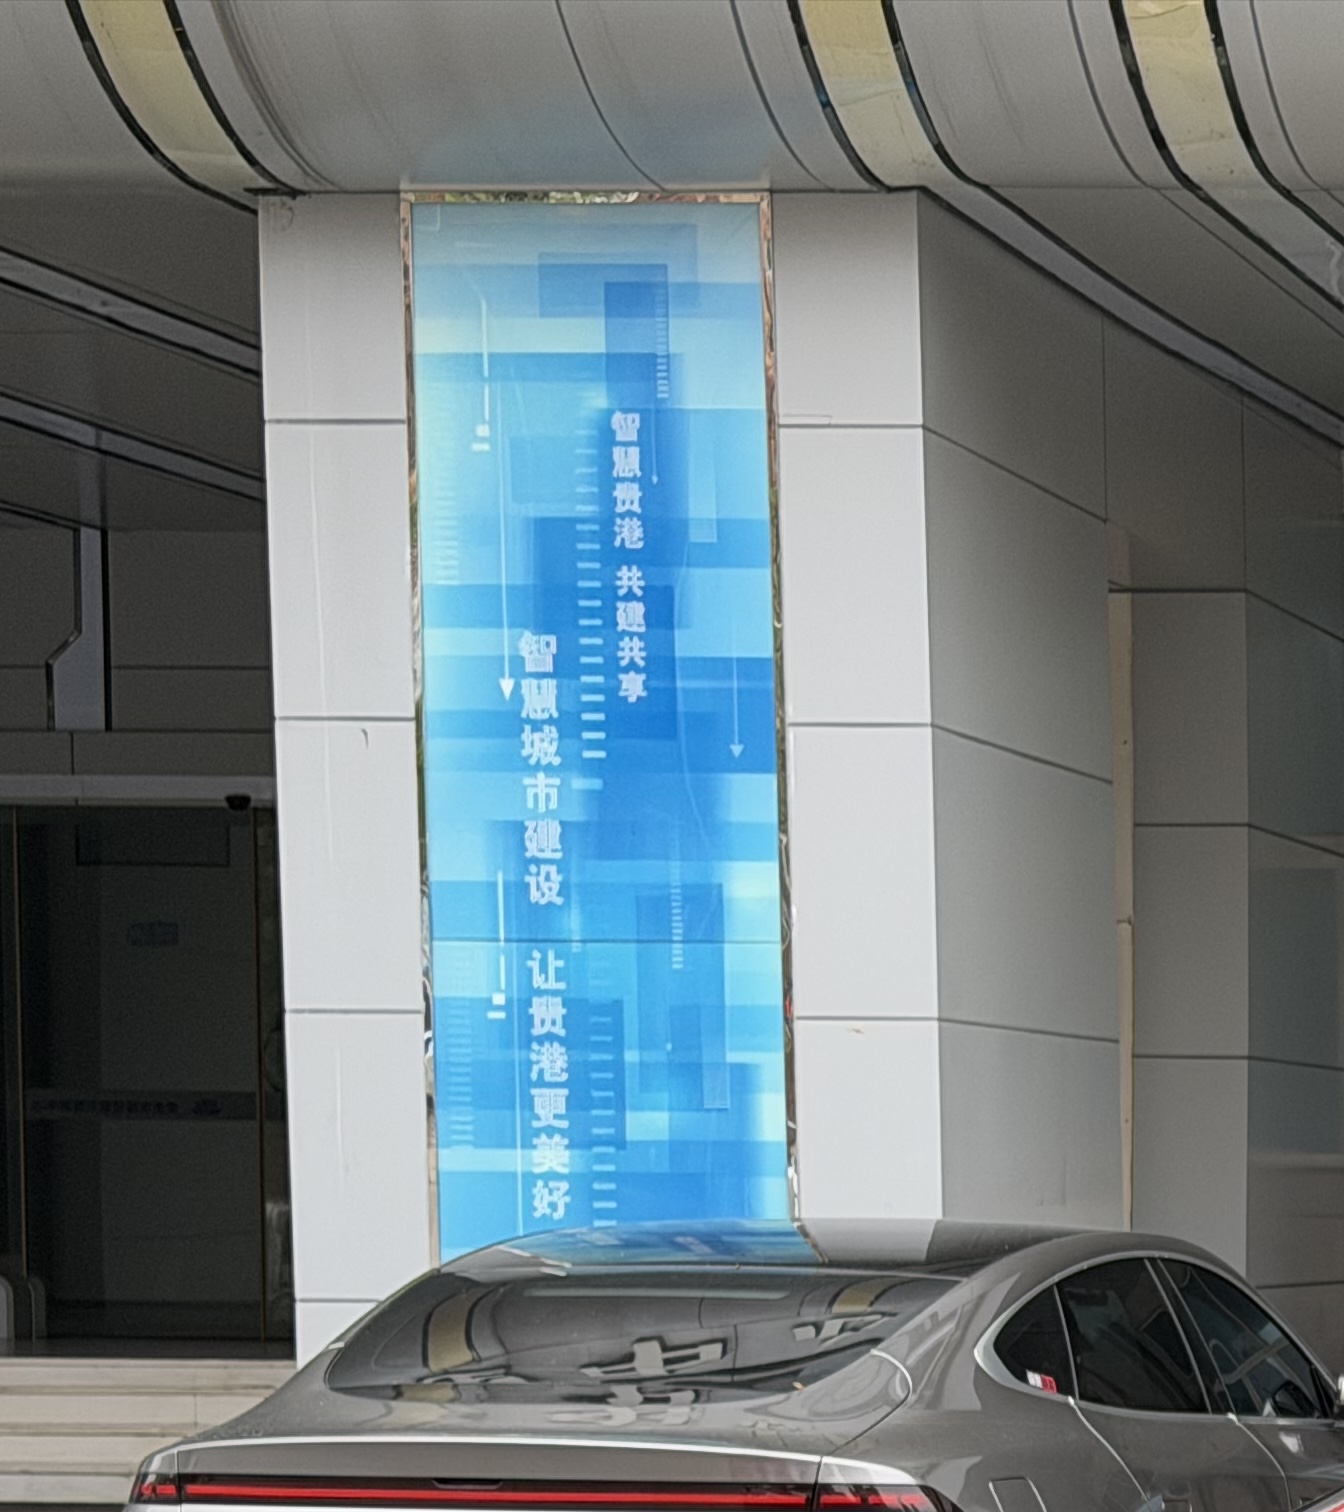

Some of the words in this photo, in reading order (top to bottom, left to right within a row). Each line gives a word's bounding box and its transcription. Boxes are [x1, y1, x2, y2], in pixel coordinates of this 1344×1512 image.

[610, 410, 644, 549] 智慧贵港
[615, 565, 647, 703] 共建共享
[518, 630, 564, 906] 智慧城市建设
[526, 949, 571, 1221] 让贵港更美好
